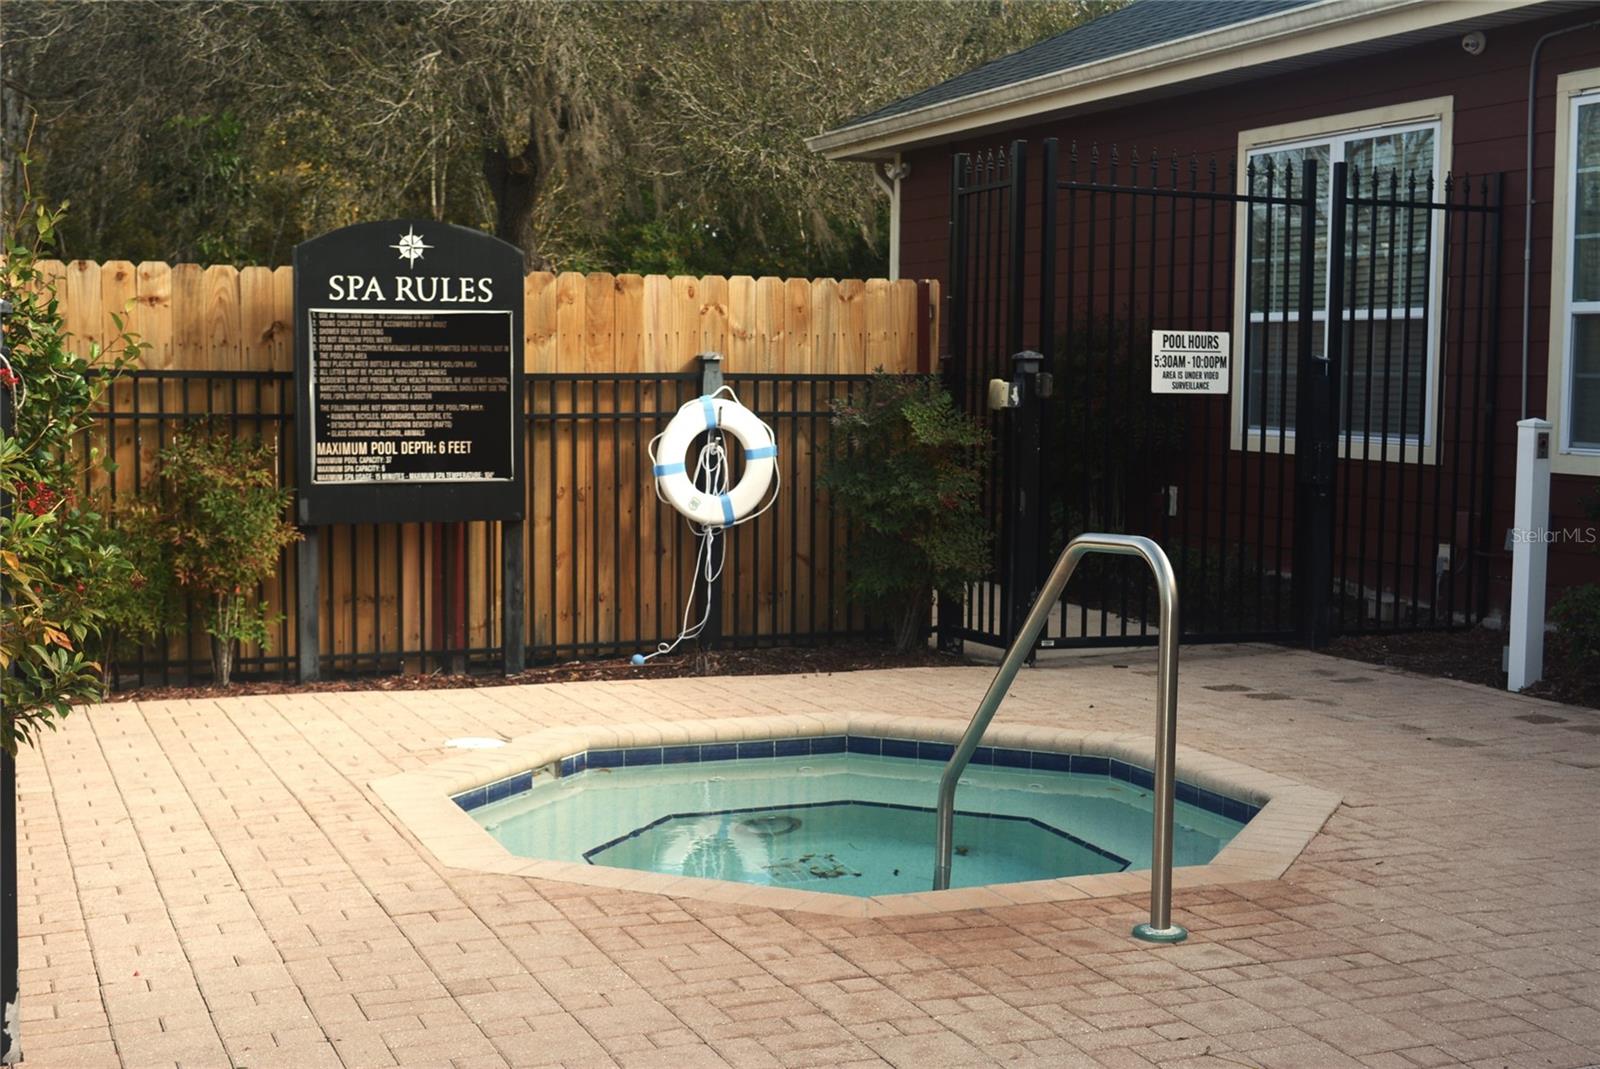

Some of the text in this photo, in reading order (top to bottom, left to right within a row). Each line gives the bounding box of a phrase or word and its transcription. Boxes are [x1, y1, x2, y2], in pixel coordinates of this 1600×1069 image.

[329, 275, 493, 302] SPA RULES
[1163, 334, 1219, 349] POOL HOURS
[1154, 355, 1186, 368] 5:30AM
[1192, 356, 1227, 368] 10:00PM
[1162, 371, 1219, 379] AREA IS UNDER VIDEO
[1172, 382, 1210, 390] SURVEILLANCE
[317, 441, 472, 455] MAXIMUM POOL DEPTH: 6 FEET
